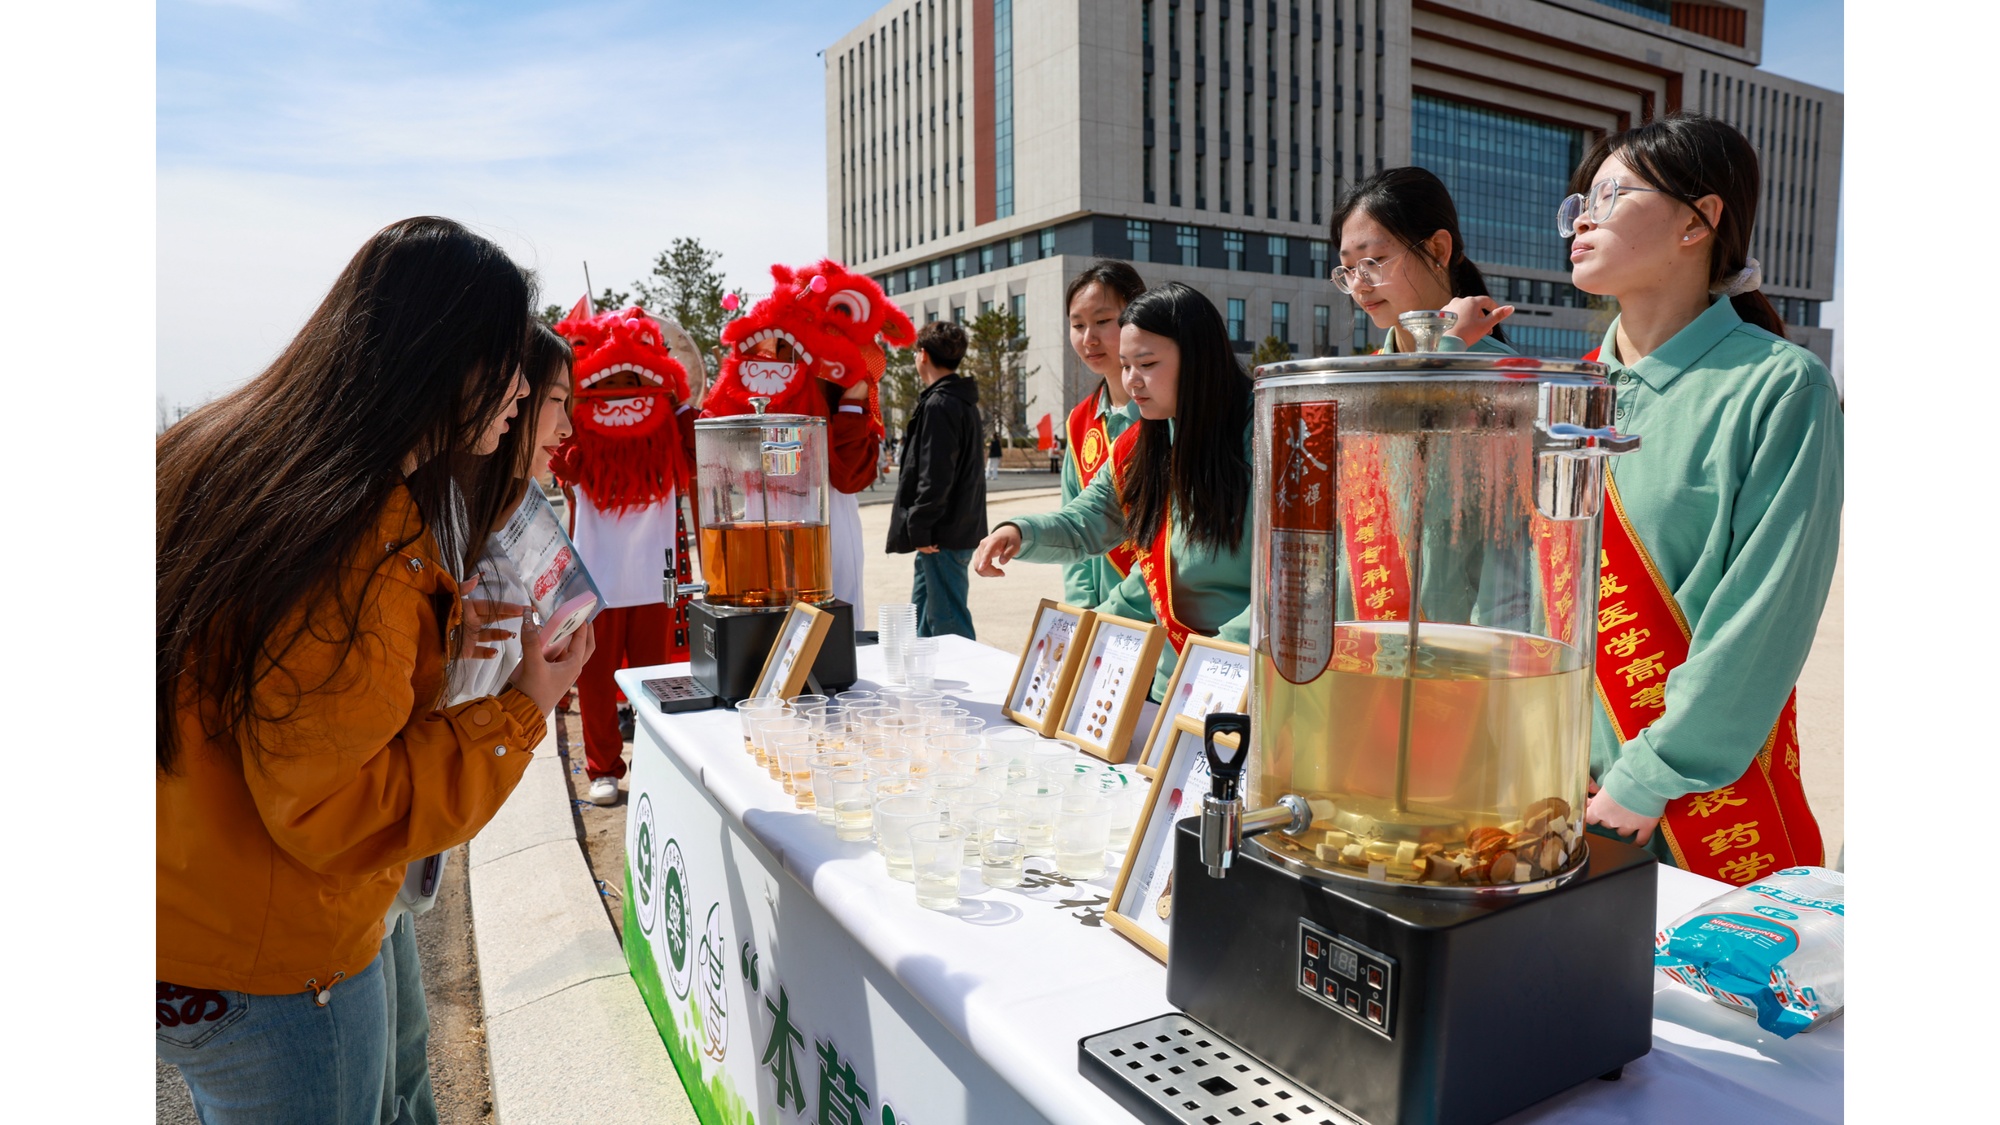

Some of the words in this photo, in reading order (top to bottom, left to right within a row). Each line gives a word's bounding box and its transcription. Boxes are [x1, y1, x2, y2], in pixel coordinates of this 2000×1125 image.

[1206, 657, 1244, 680] 泻白散
[1597, 549, 1666, 728] 城医学高等
